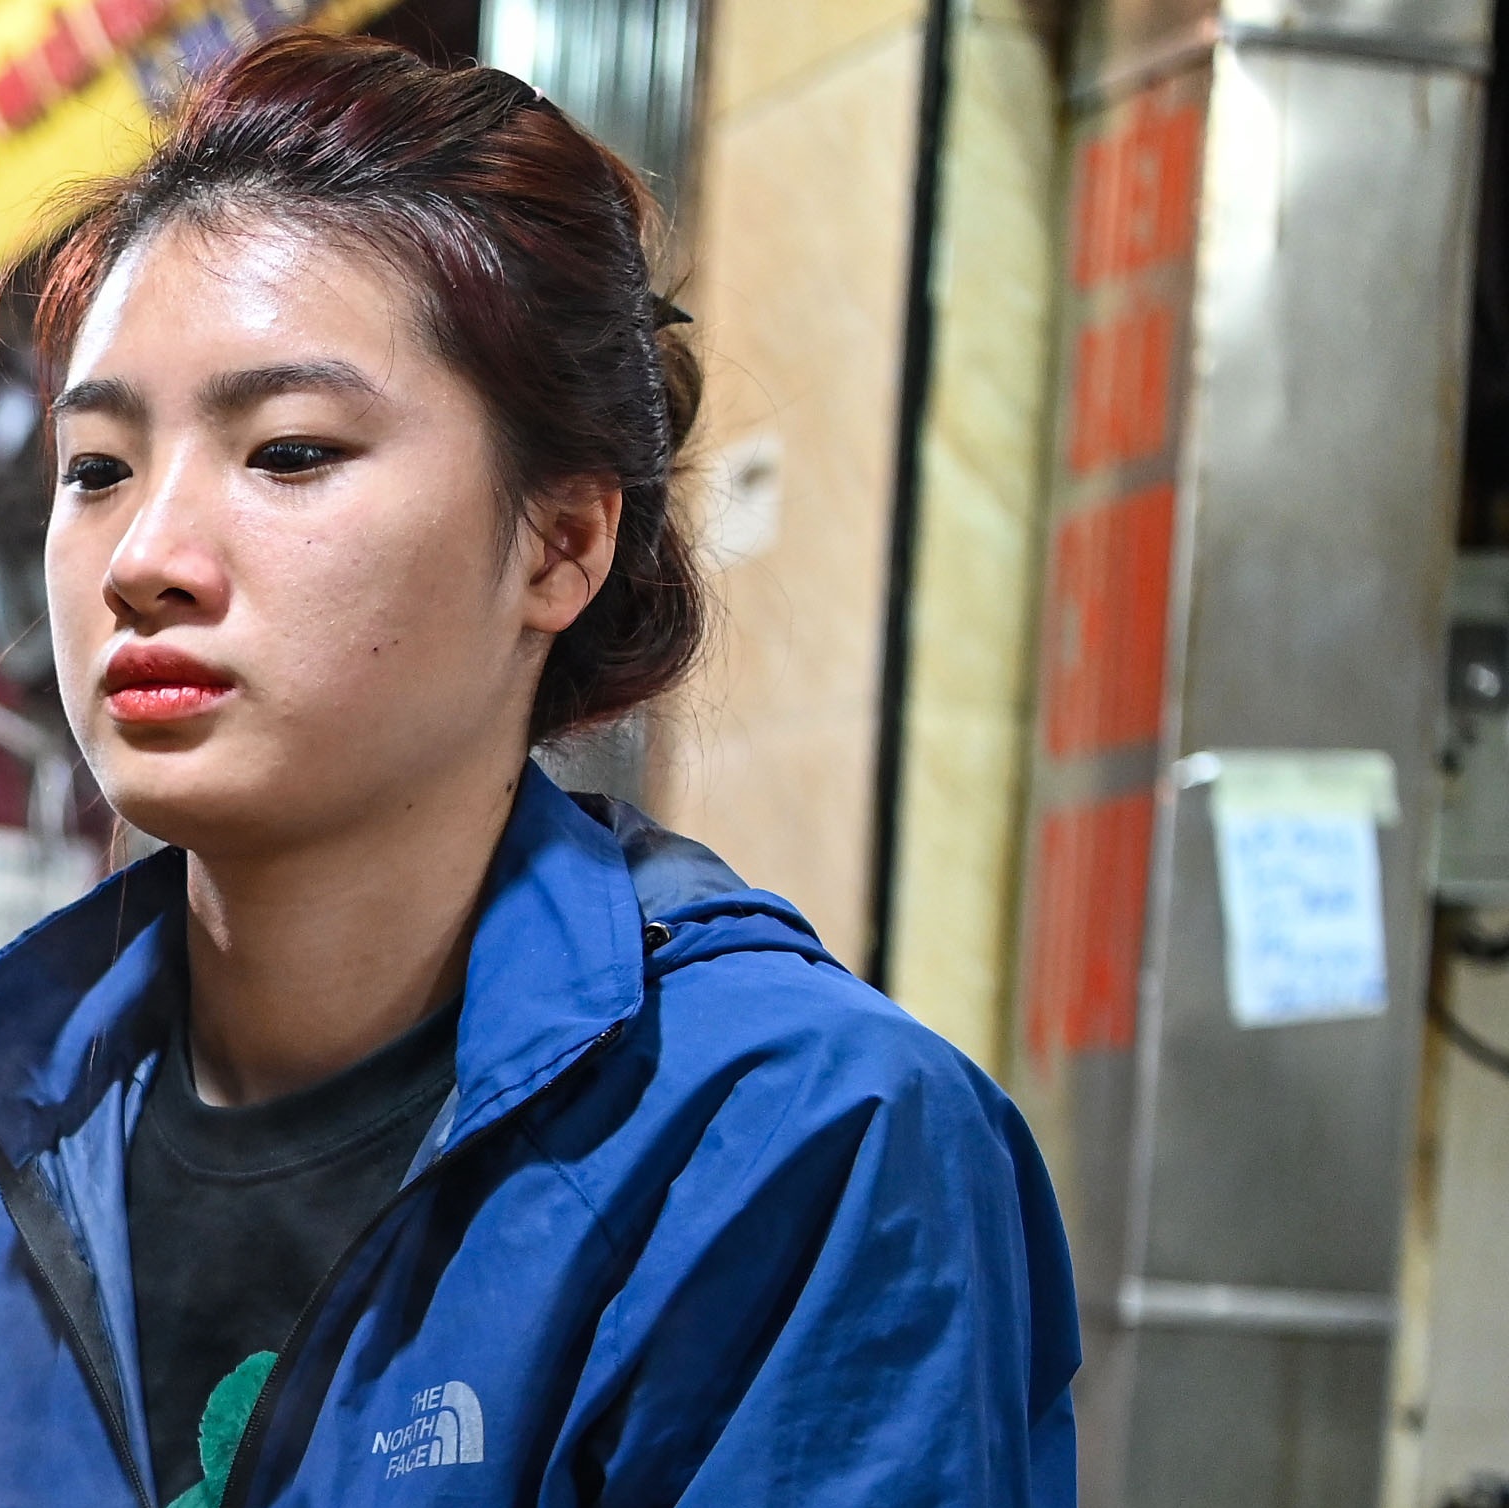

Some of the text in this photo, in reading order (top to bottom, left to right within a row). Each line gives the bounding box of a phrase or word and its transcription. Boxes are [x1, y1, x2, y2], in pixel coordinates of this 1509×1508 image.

[411, 1385, 442, 1417] THE
[372, 1415, 436, 1454] NORTH
[385, 1444, 430, 1480] FACE
